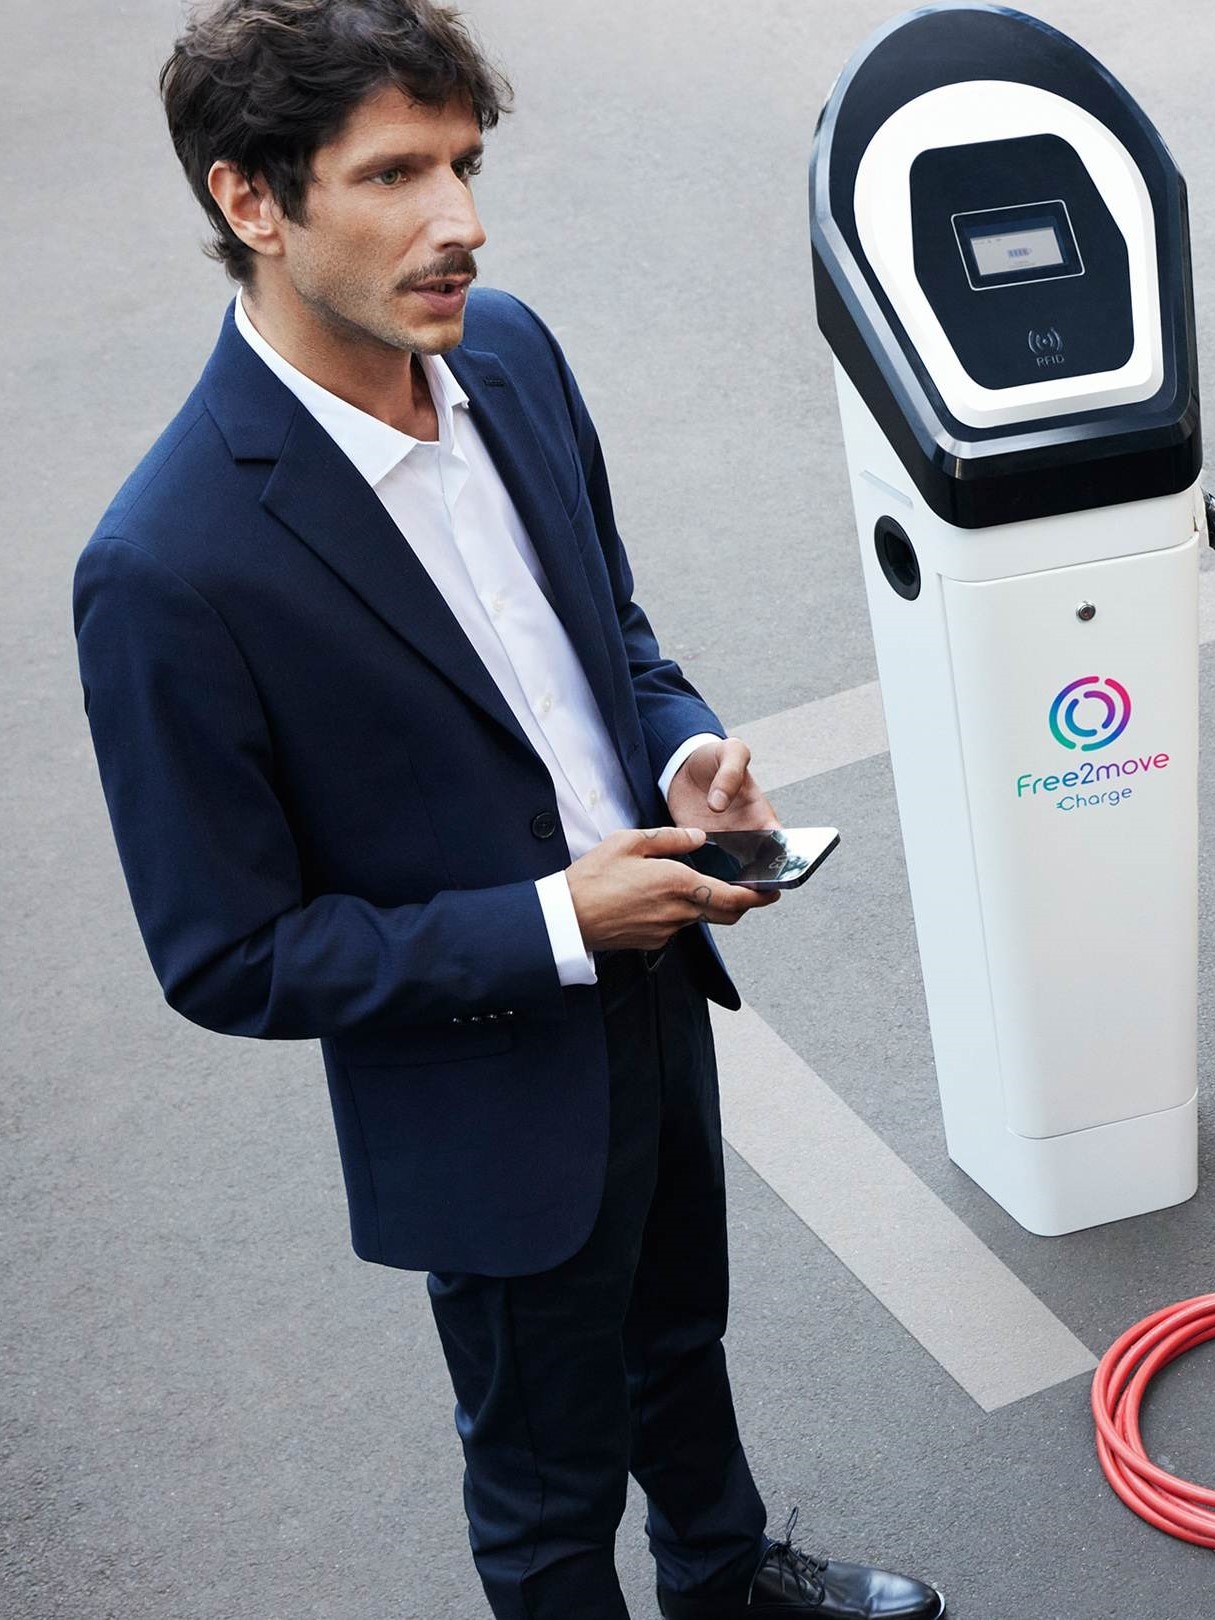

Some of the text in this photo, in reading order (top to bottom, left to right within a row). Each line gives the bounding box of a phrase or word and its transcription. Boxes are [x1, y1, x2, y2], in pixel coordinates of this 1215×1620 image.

[1036, 354, 1065, 368] RFID
[1017, 753, 1170, 797] Free2move
[1057, 788, 1132, 811] Charge
